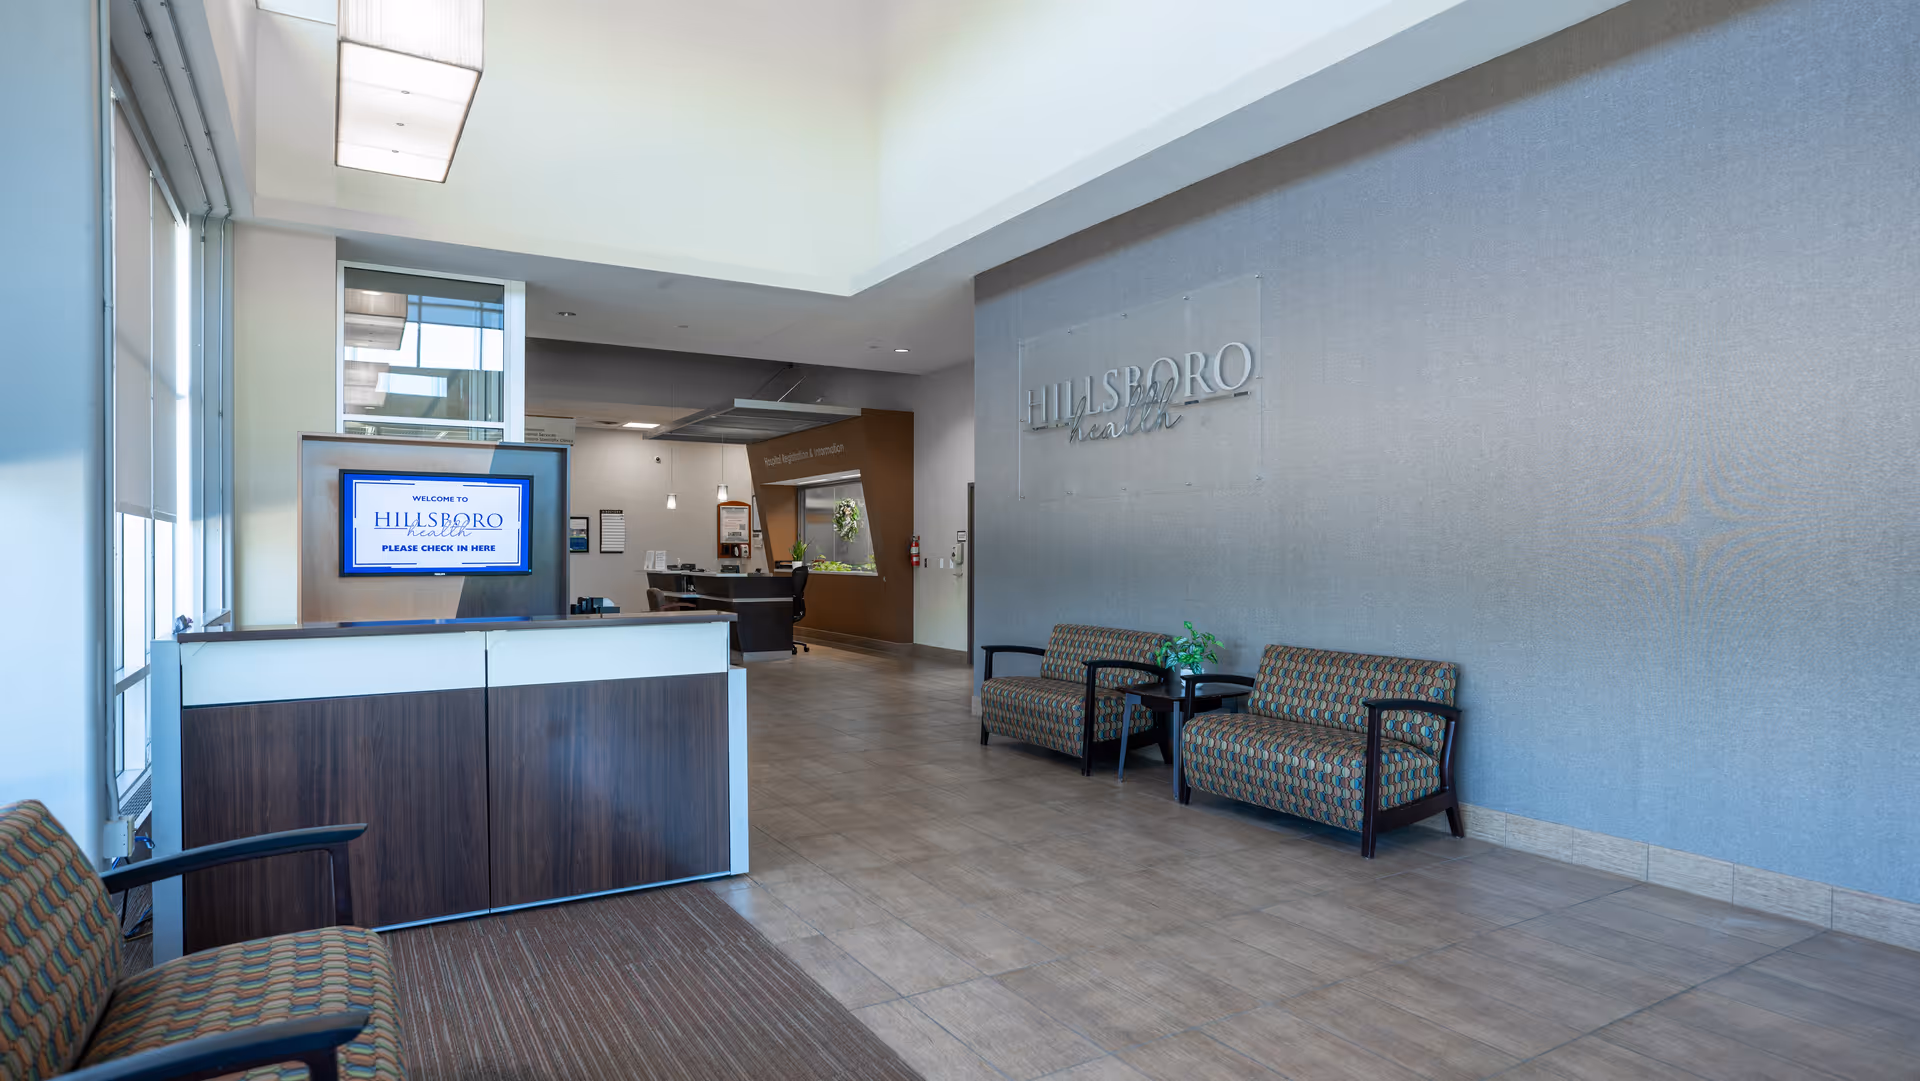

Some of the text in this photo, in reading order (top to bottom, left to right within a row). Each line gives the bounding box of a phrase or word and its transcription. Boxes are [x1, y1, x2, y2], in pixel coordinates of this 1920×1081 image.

[1028, 341, 1252, 425] HILLSBORO
[1069, 377, 1184, 443] health
[374, 512, 503, 528] HILLSBORO
[407, 519, 472, 537] health
